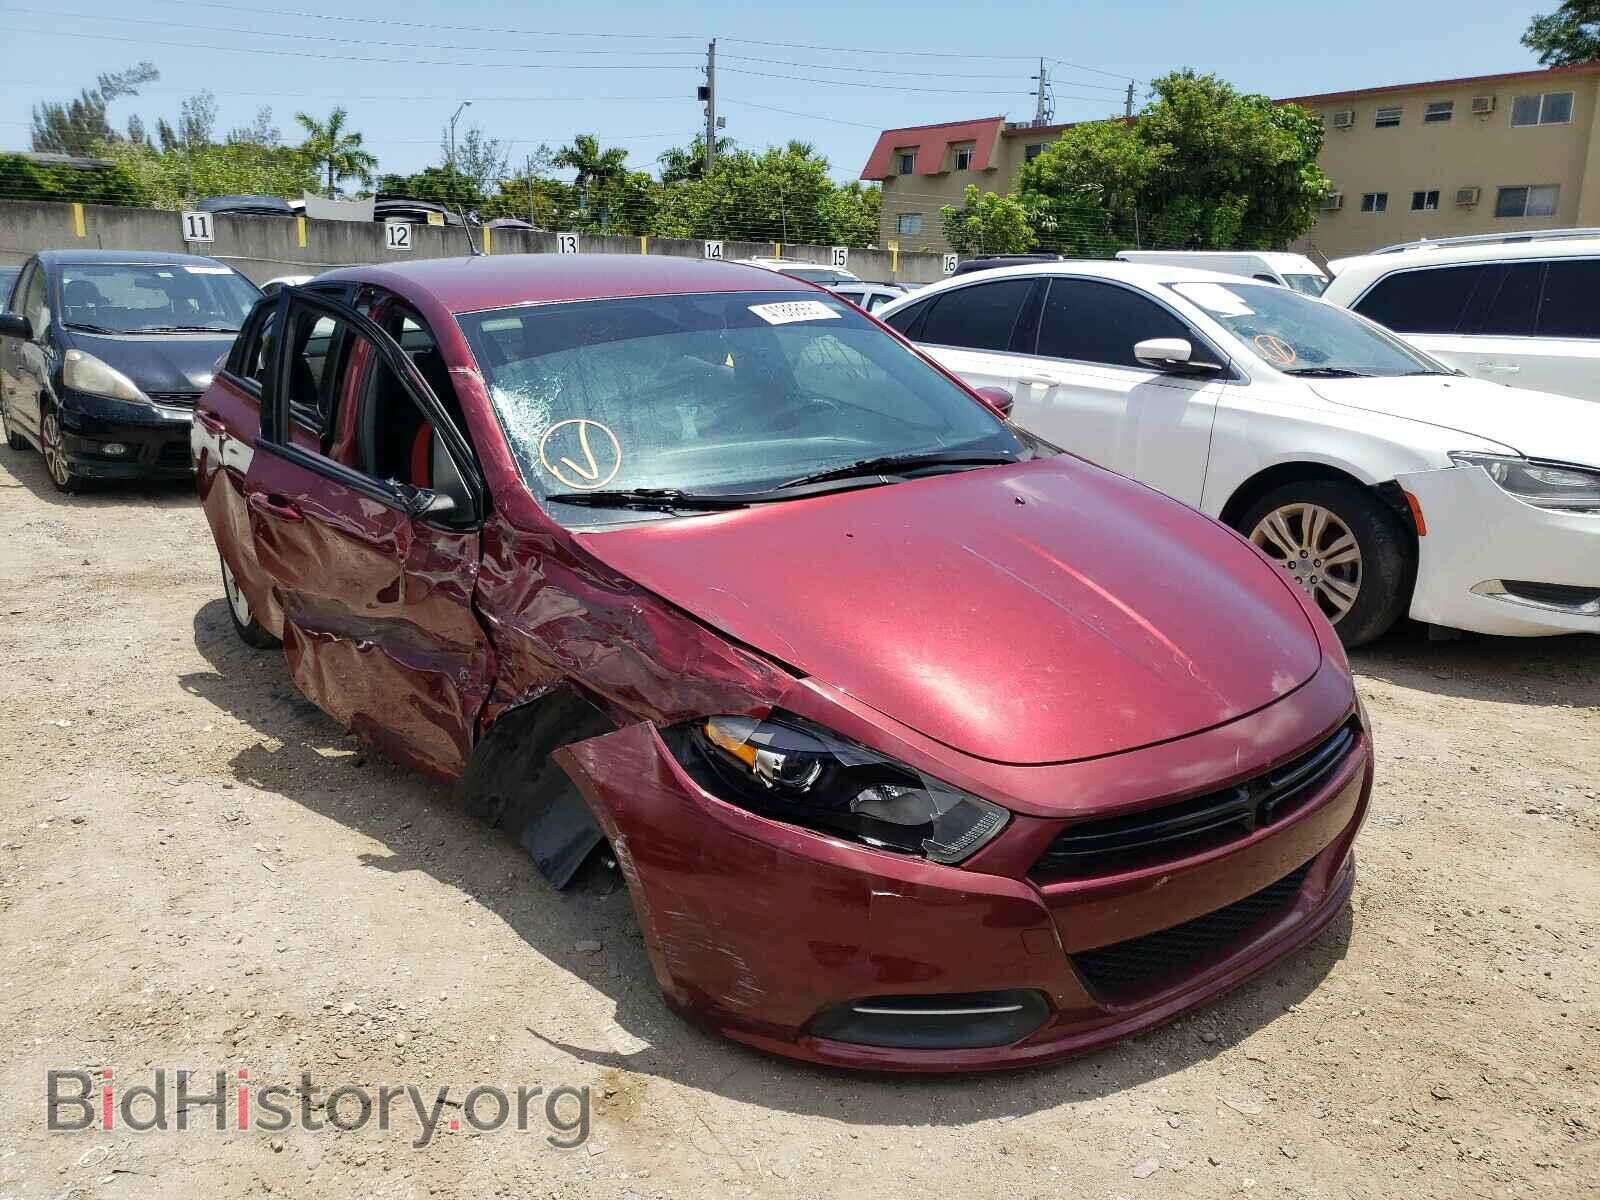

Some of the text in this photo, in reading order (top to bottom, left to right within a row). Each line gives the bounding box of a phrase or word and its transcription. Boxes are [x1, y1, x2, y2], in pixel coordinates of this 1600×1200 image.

[187, 215, 209, 238] 11
[390, 226, 409, 247] 12
[559, 236, 577, 254] 13
[707, 243, 722, 258] 14
[833, 249, 847, 266] 15
[944, 256, 956, 272] 16
